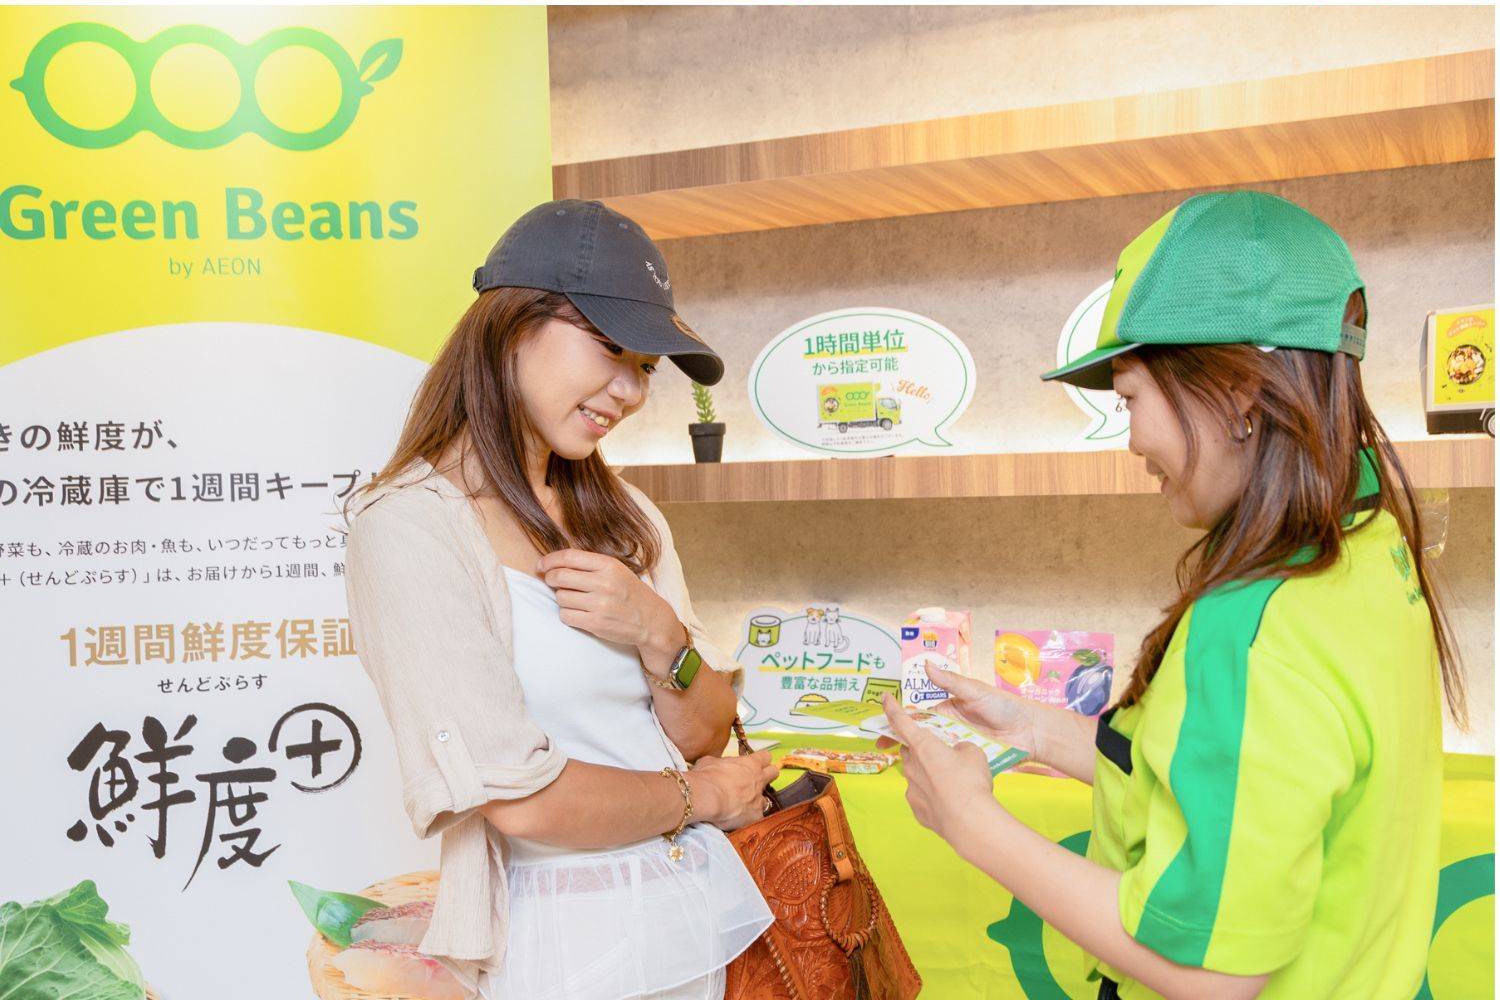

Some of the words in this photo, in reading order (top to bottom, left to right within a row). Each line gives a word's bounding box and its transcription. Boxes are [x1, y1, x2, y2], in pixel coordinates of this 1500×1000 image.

[0, 184, 199, 241] Green
[225, 187, 419, 241] Beans
[169, 257, 193, 279] by
[202, 257, 262, 276] AEON
[803, 328, 906, 356] 1時間単位
[813, 357, 899, 376] から指定可能
[0, 468, 380, 507] の冷蔵庫で1週間キープ
[59, 618, 358, 668] 1週間鮮度保証
[762, 651, 885, 672] ペットフードも
[780, 675, 860, 692] 豊富な品揃え
